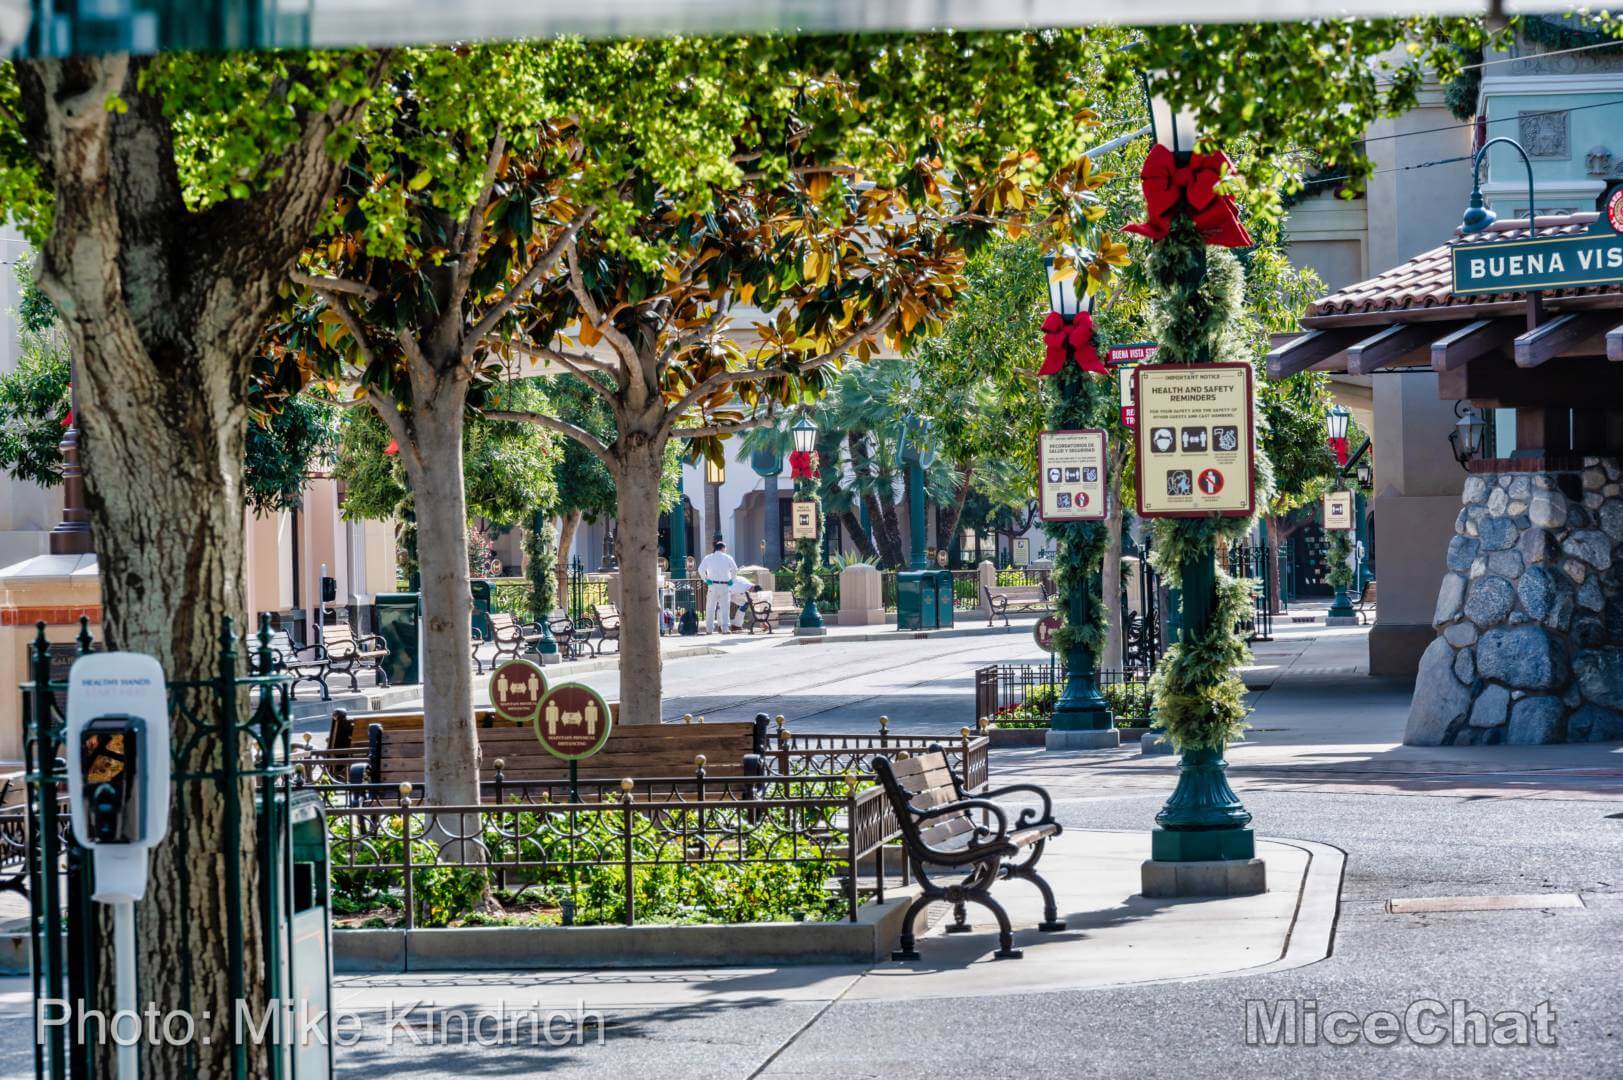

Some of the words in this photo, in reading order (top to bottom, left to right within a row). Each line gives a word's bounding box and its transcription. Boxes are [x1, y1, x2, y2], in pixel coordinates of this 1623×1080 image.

[1470, 252, 1565, 279] BUENA
[1577, 247, 1623, 270] VIS
[1112, 349, 1128, 360] BUENA
[1130, 348, 1144, 359] VISTA
[1152, 386, 1183, 394] HEALTH
[1203, 385, 1234, 393] SAFETY
[1170, 394, 1216, 402] REMINDERS
